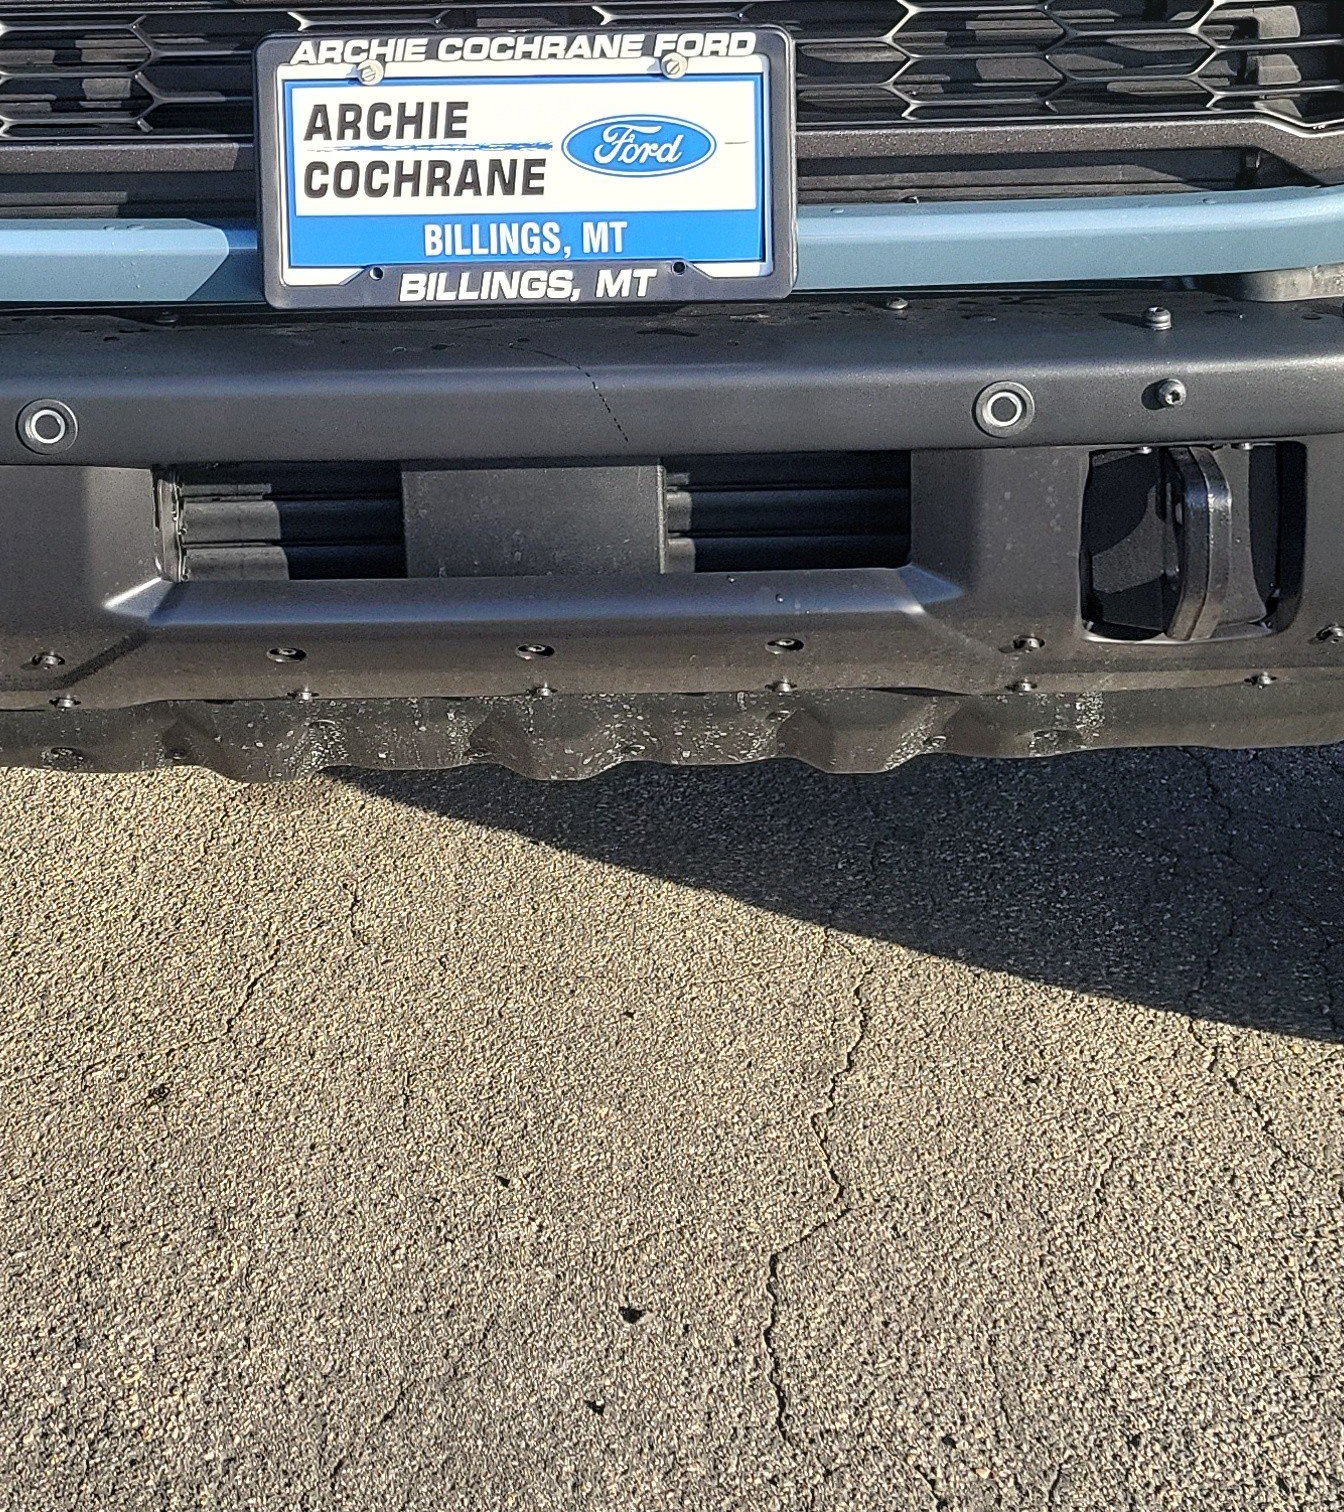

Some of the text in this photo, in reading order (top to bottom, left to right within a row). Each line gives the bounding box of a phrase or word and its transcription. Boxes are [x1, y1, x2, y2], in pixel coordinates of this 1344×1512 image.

[290, 31, 757, 65] ARCHIE COCHRANE FORD
[303, 101, 469, 141] ARCHIE
[593, 123, 686, 167] Ford
[303, 158, 546, 199] COCHRANE
[423, 220, 628, 259] BILLINGS, MT
[398, 268, 659, 304] BILLINGS, MT
